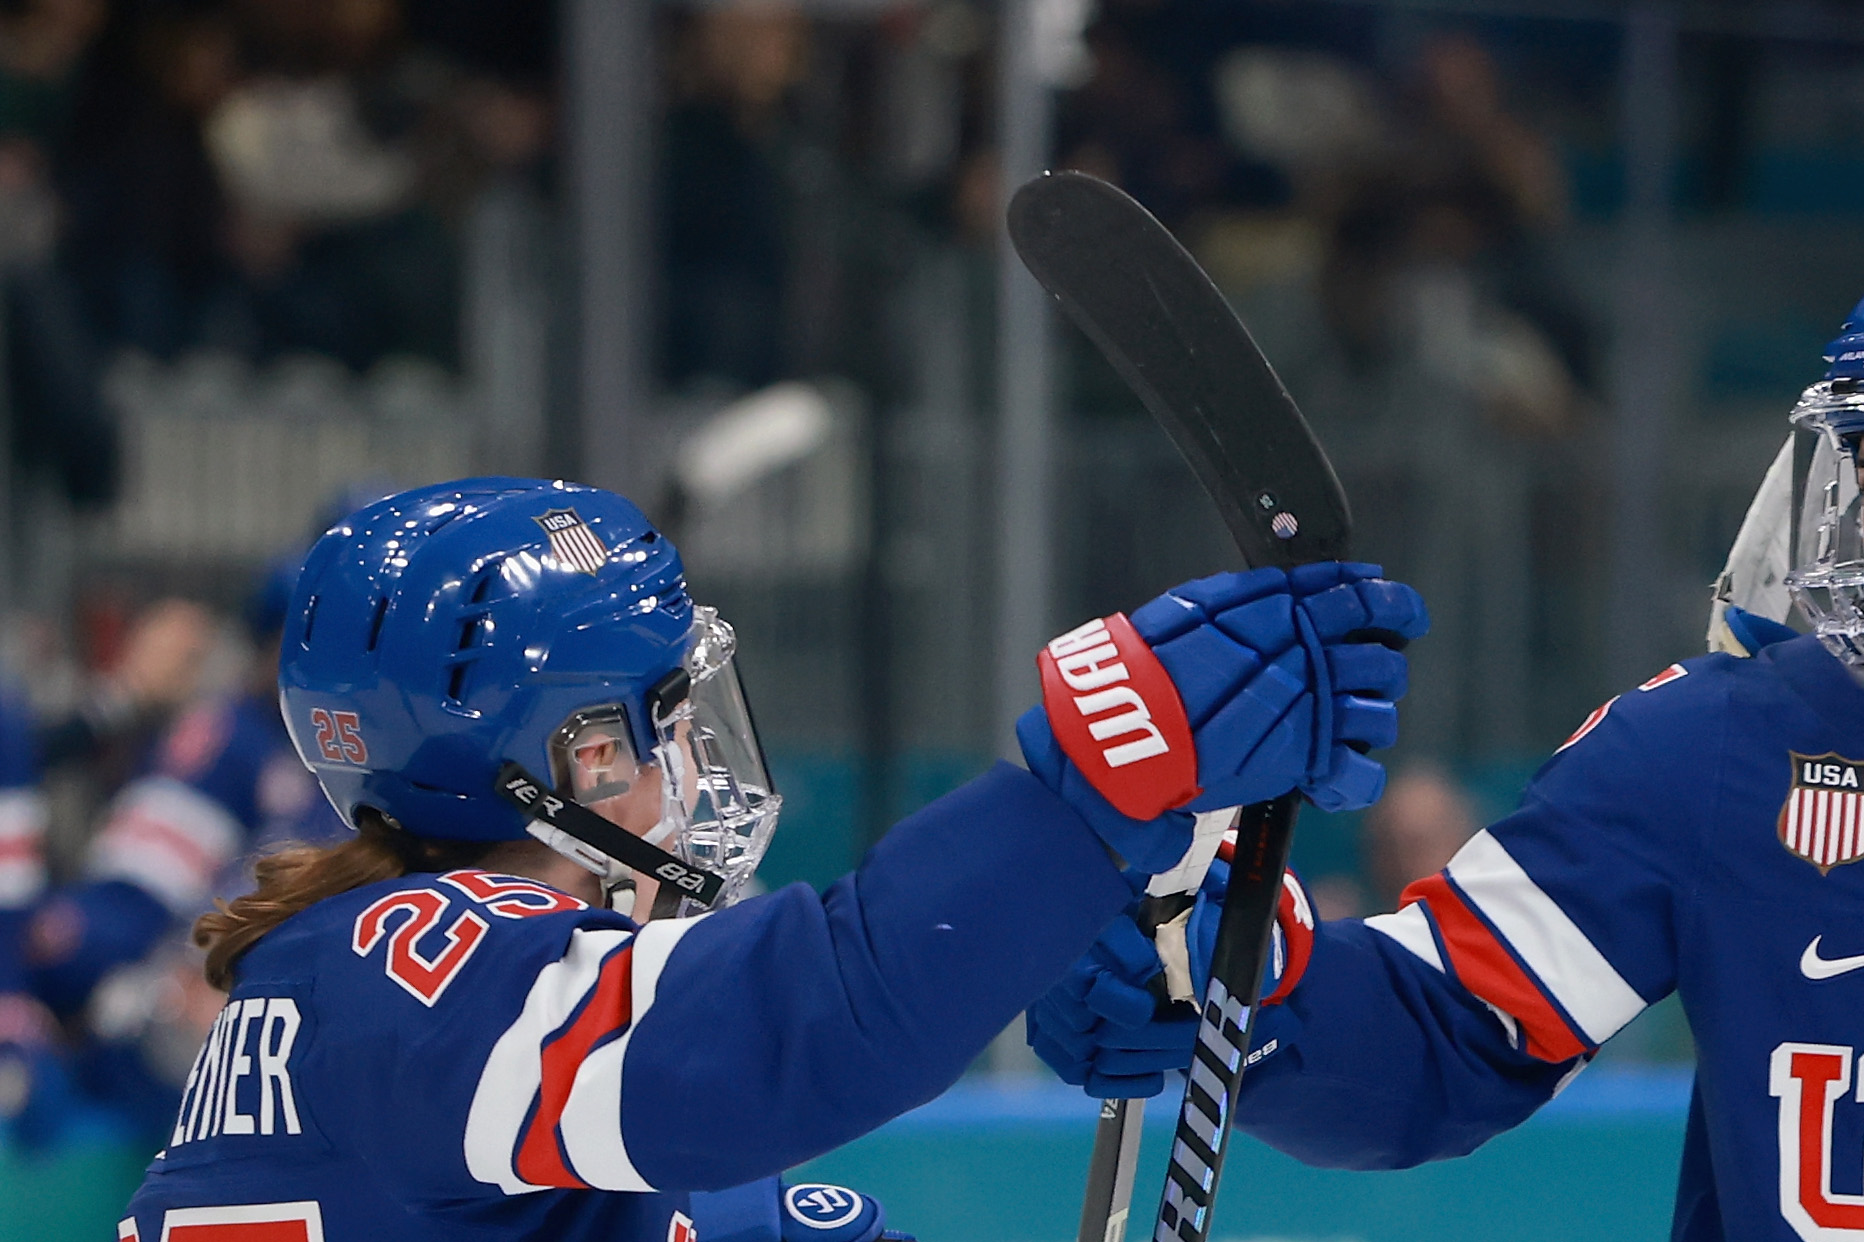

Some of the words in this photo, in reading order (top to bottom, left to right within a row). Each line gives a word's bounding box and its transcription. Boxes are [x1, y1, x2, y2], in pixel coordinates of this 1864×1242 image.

[543, 513, 577, 531] USA
[311, 708, 368, 764] 25
[1803, 762, 1859, 788] USA
[352, 870, 589, 1007] 25
